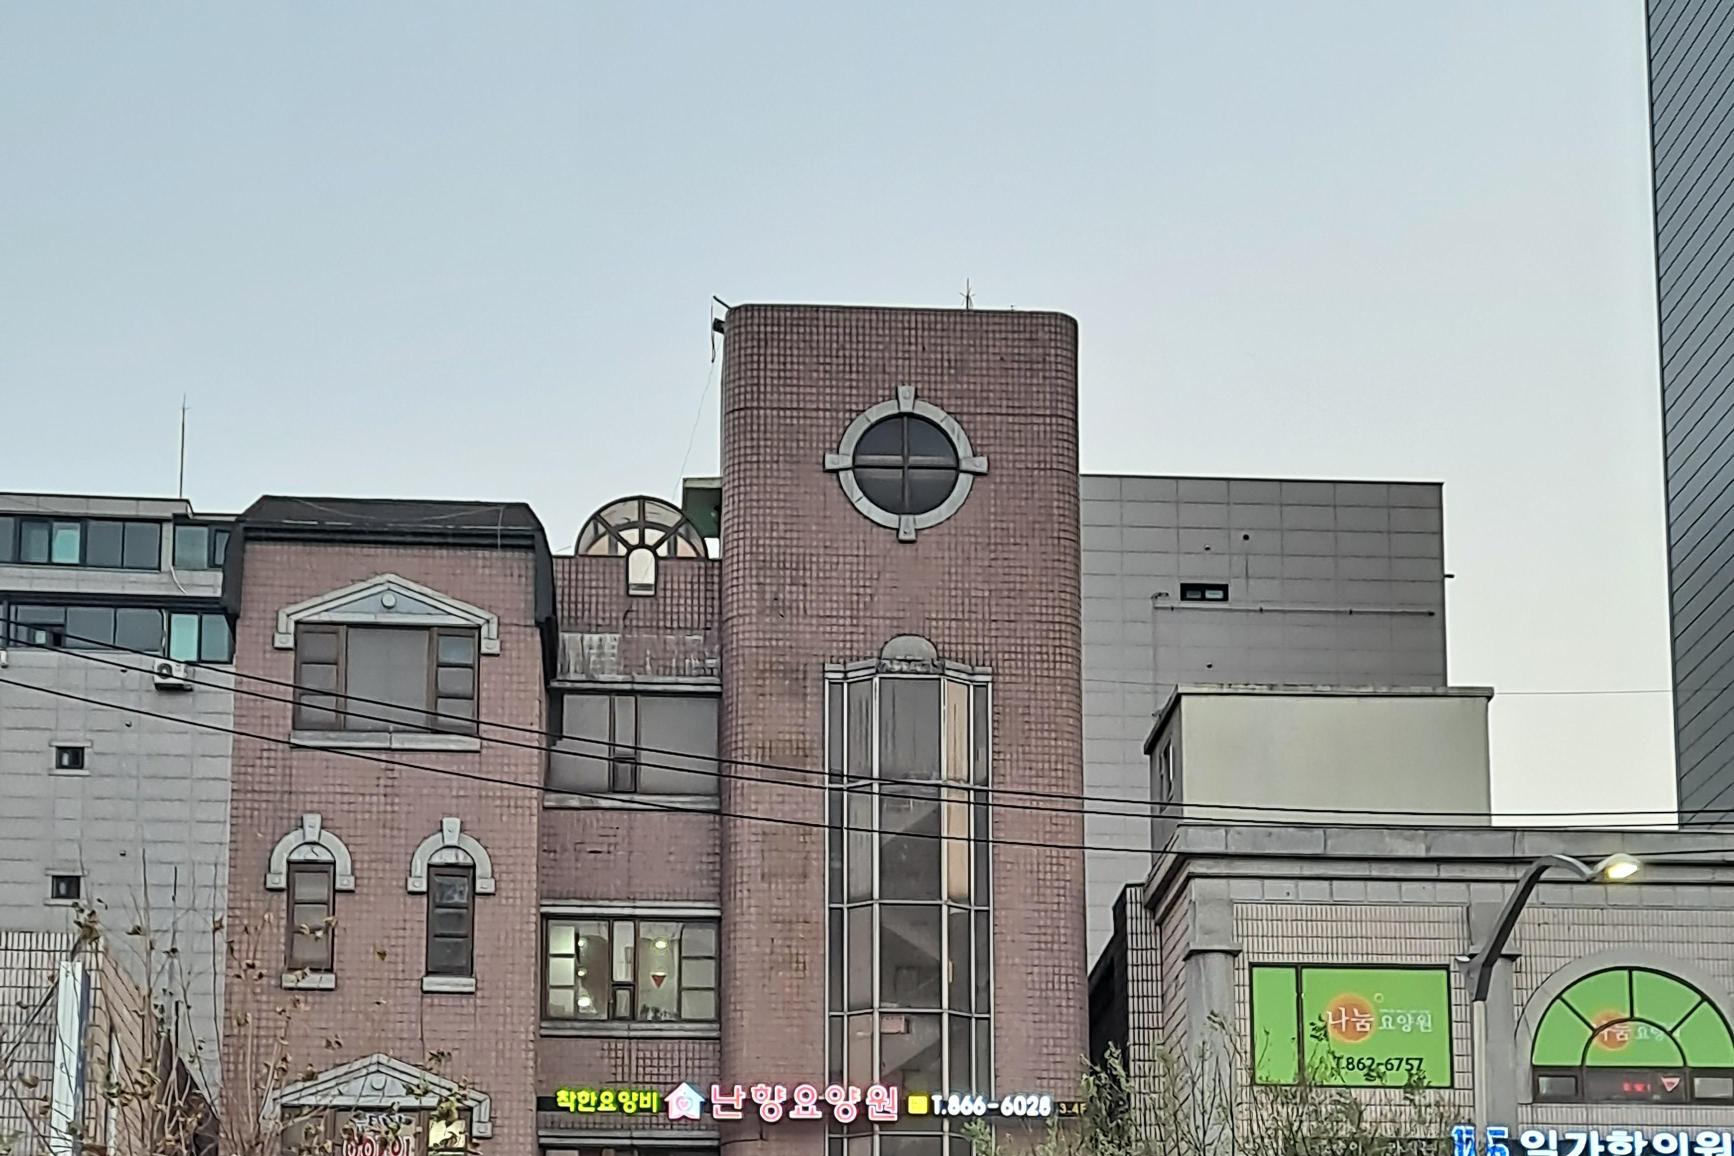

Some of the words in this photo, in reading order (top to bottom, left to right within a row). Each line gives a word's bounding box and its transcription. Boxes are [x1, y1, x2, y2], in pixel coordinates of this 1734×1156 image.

[1327, 1006, 1376, 1033] 나눔
[1379, 1012, 1433, 1033] 요양원
[556, 1088, 658, 1114] 착한요양비
[711, 1083, 898, 1123] 난향요양원
[931, 1094, 1051, 1117] T.866-6028
